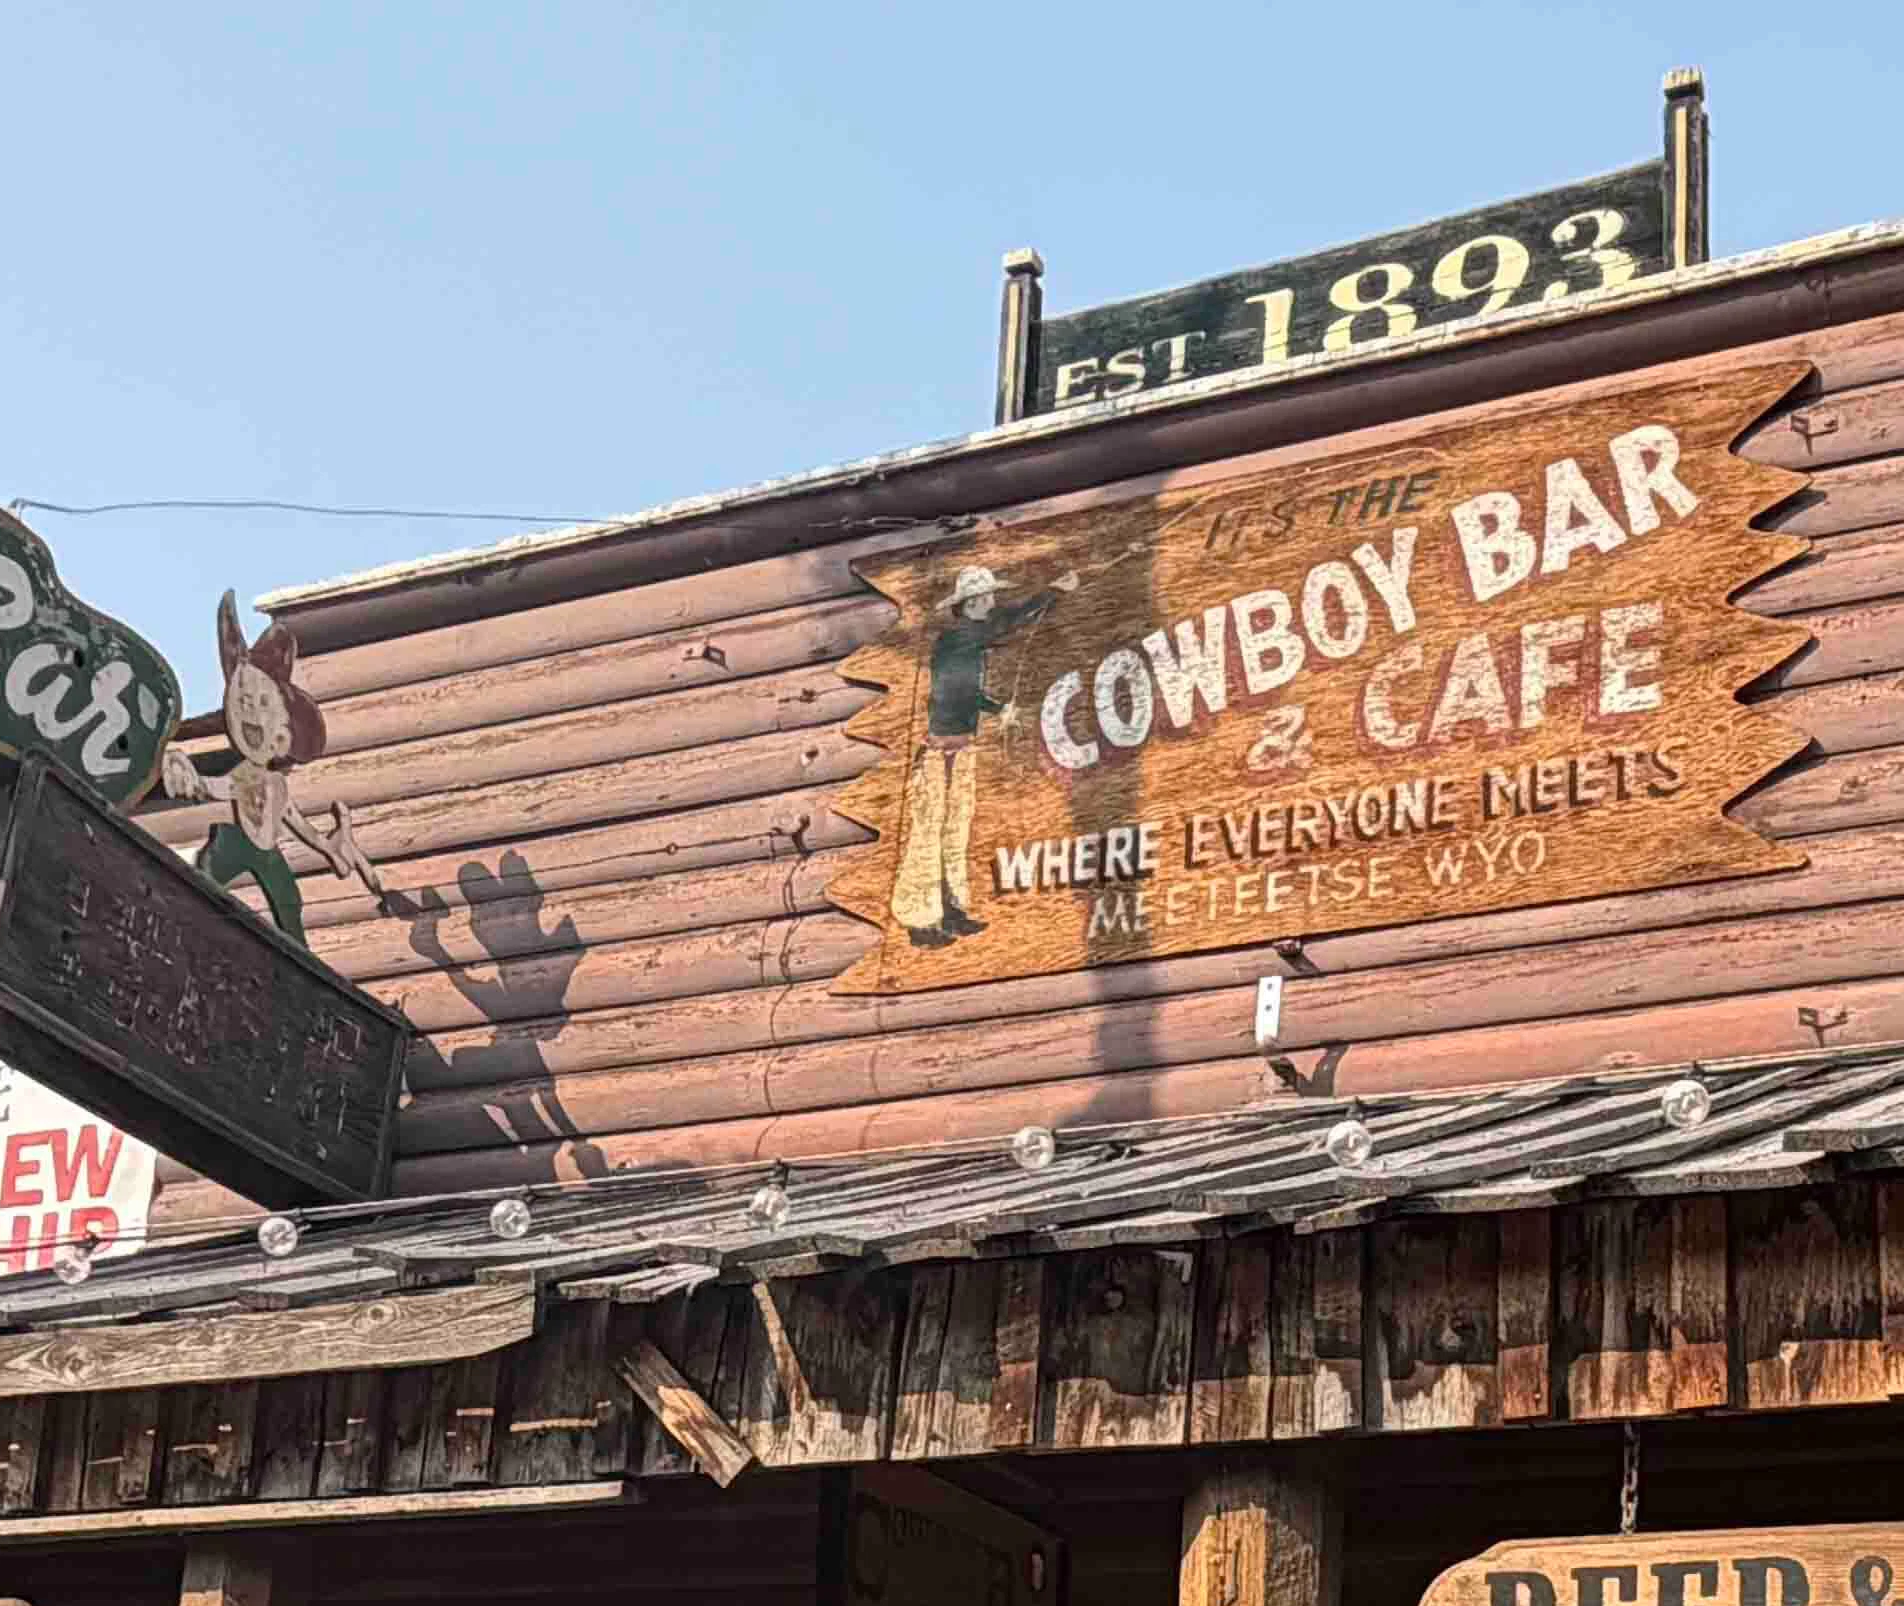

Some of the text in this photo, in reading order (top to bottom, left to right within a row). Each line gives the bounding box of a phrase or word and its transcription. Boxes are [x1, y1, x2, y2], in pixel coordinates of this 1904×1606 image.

[1054, 207, 1637, 405] EST 1893
[1326, 471, 1441, 528] THE
[1039, 422, 1702, 772] COWBOY BAR
[1246, 600, 1670, 774] & CAFE
[994, 738, 1688, 896] WHERE EVERYONE MEETS
[1086, 829, 1548, 940] MEETEETSE WYO
